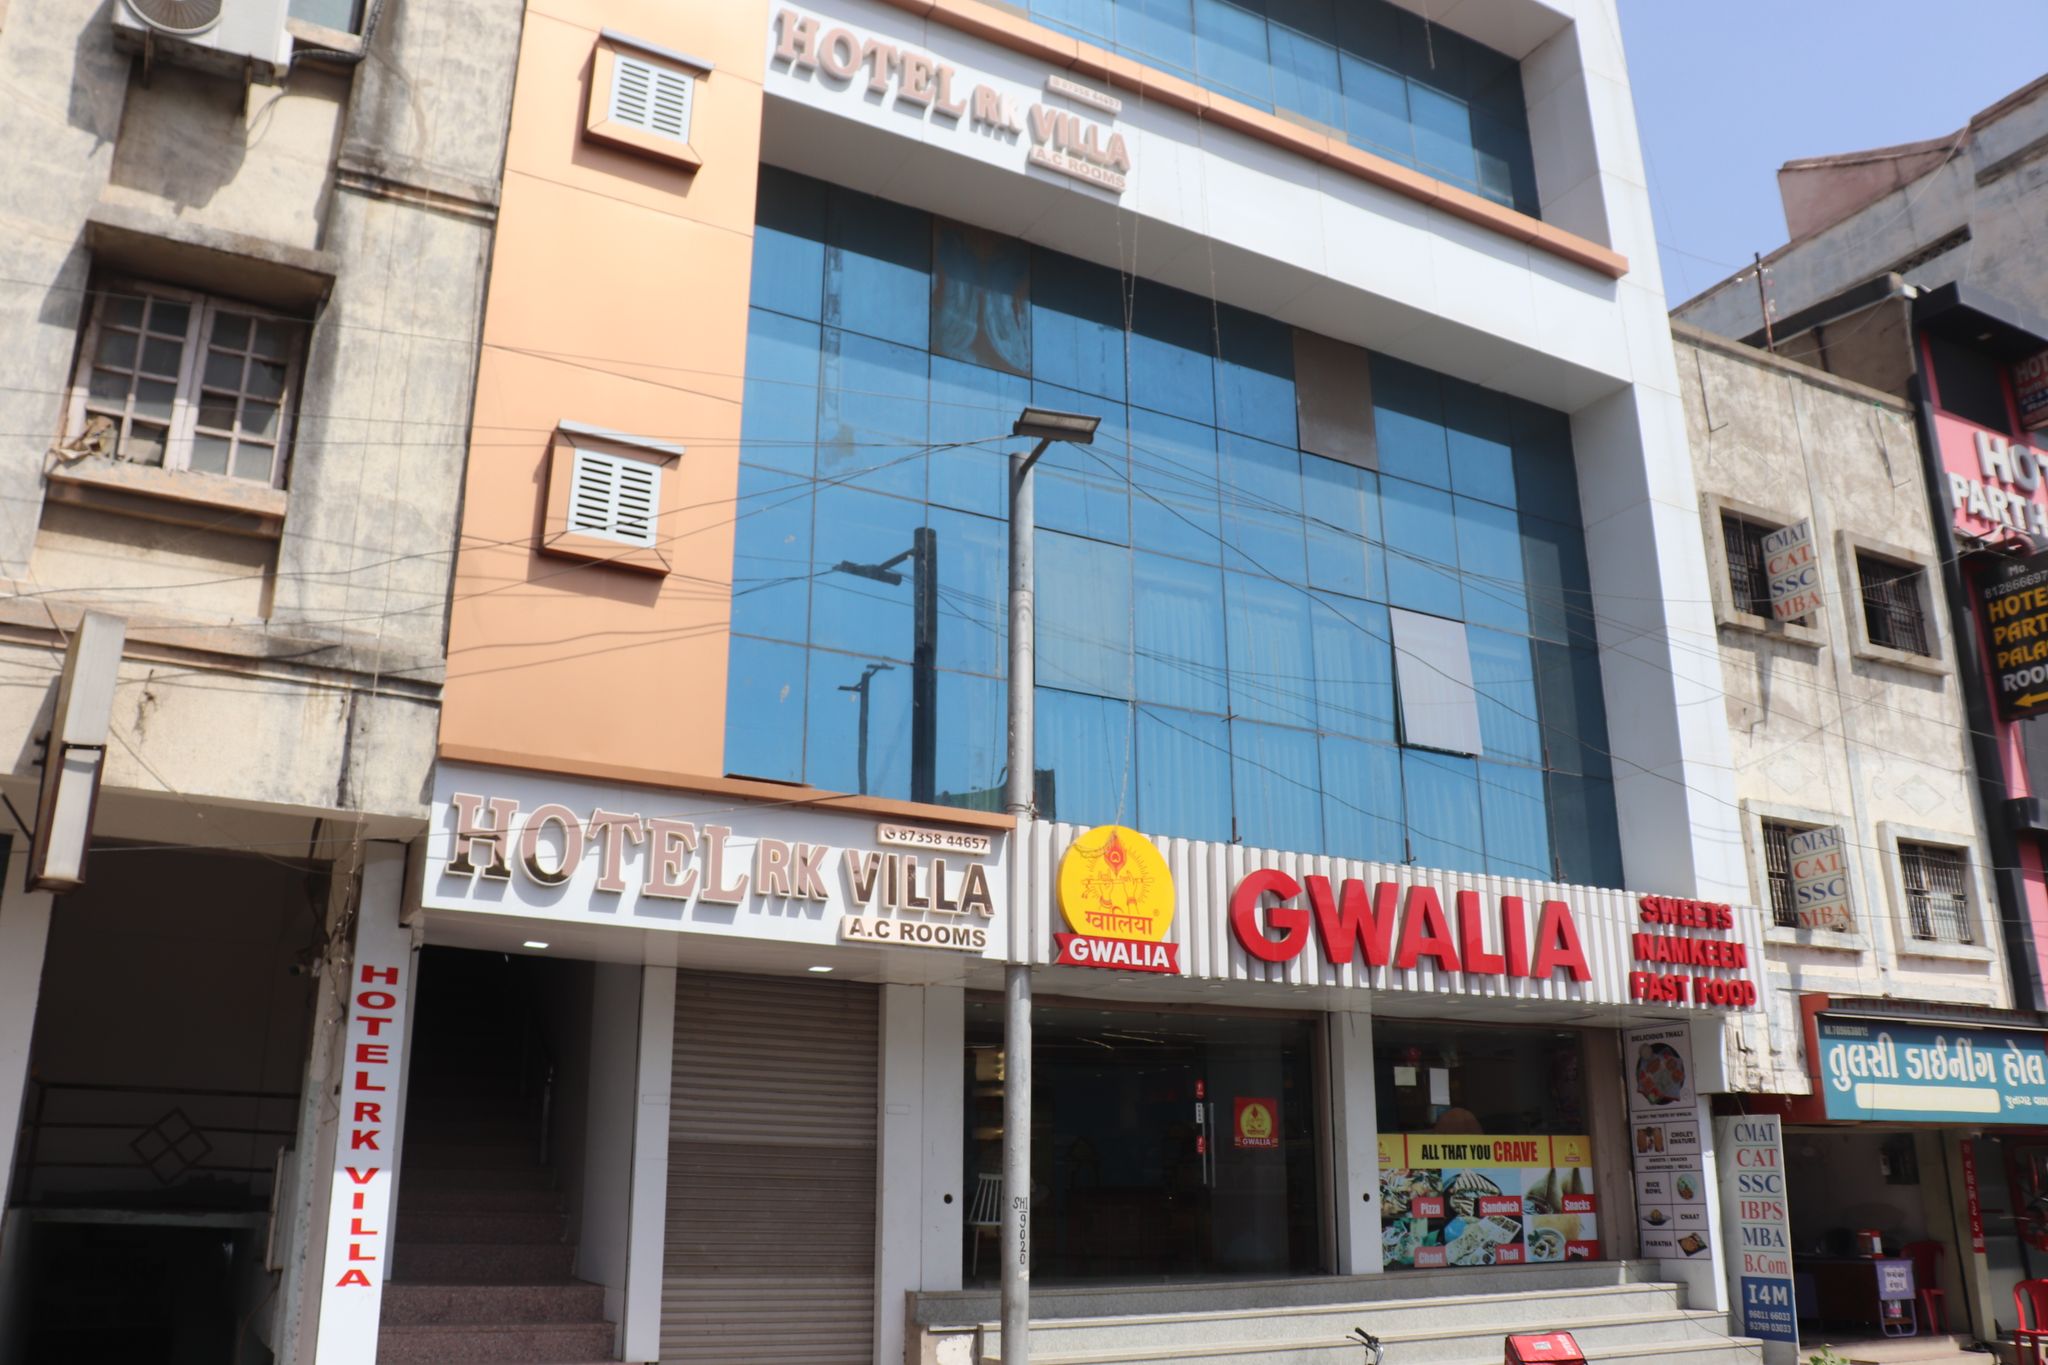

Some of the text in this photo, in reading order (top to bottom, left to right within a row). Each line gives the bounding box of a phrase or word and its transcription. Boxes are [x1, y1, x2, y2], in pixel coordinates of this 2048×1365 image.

[776, 9, 1130, 172] HOTEL RK VILLA
[1069, 159, 1126, 188] ROOMS
[1766, 522, 1807, 553] CMAT
[1768, 544, 1811, 575] CAT
[1772, 568, 1815, 598] SSC
[1774, 591, 1822, 617] MBA
[2003, 663, 2048, 692] ROO
[900, 830, 988, 851] 87358 44657
[1791, 829, 1836, 855] CMAT
[445, 792, 995, 918] HOTEL RK VILLA
[1794, 853, 1840, 878] CAT
[1798, 878, 1846, 904] SSC
[1085, 907, 1153, 935] ग्वालिया
[1230, 868, 1592, 982] GWALIA
[1639, 895, 1733, 929] SWEETS
[1799, 903, 1850, 928] MBA
[850, 918, 986, 948] A.C ROOMS
[1069, 938, 1170, 968] GWALIA
[1632, 932, 1747, 969] NAMKEEN
[1629, 971, 1757, 1007] FAST FOOD
[1829, 1032, 1899, 1092] તુલસી
[1734, 1123, 1776, 1142] CMAT
[1421, 1141, 1538, 1162] ALL THAT YOU CRAVE
[1736, 1149, 1778, 1168] CAT
[1739, 1174, 1781, 1194] SSC
[1420, 1202, 1441, 1215] Pizza
[1482, 1200, 1519, 1213] Sandwich
[1564, 1199, 1591, 1212] Snacks
[1740, 1200, 1784, 1221] IBPS
[335, 1167, 379, 1287] VILLA
[1742, 1226, 1785, 1248] MBA
[1500, 1246, 1519, 1260] Thali
[1744, 1254, 1788, 1275] B.Com
[1748, 1284, 1788, 1306] I4M
